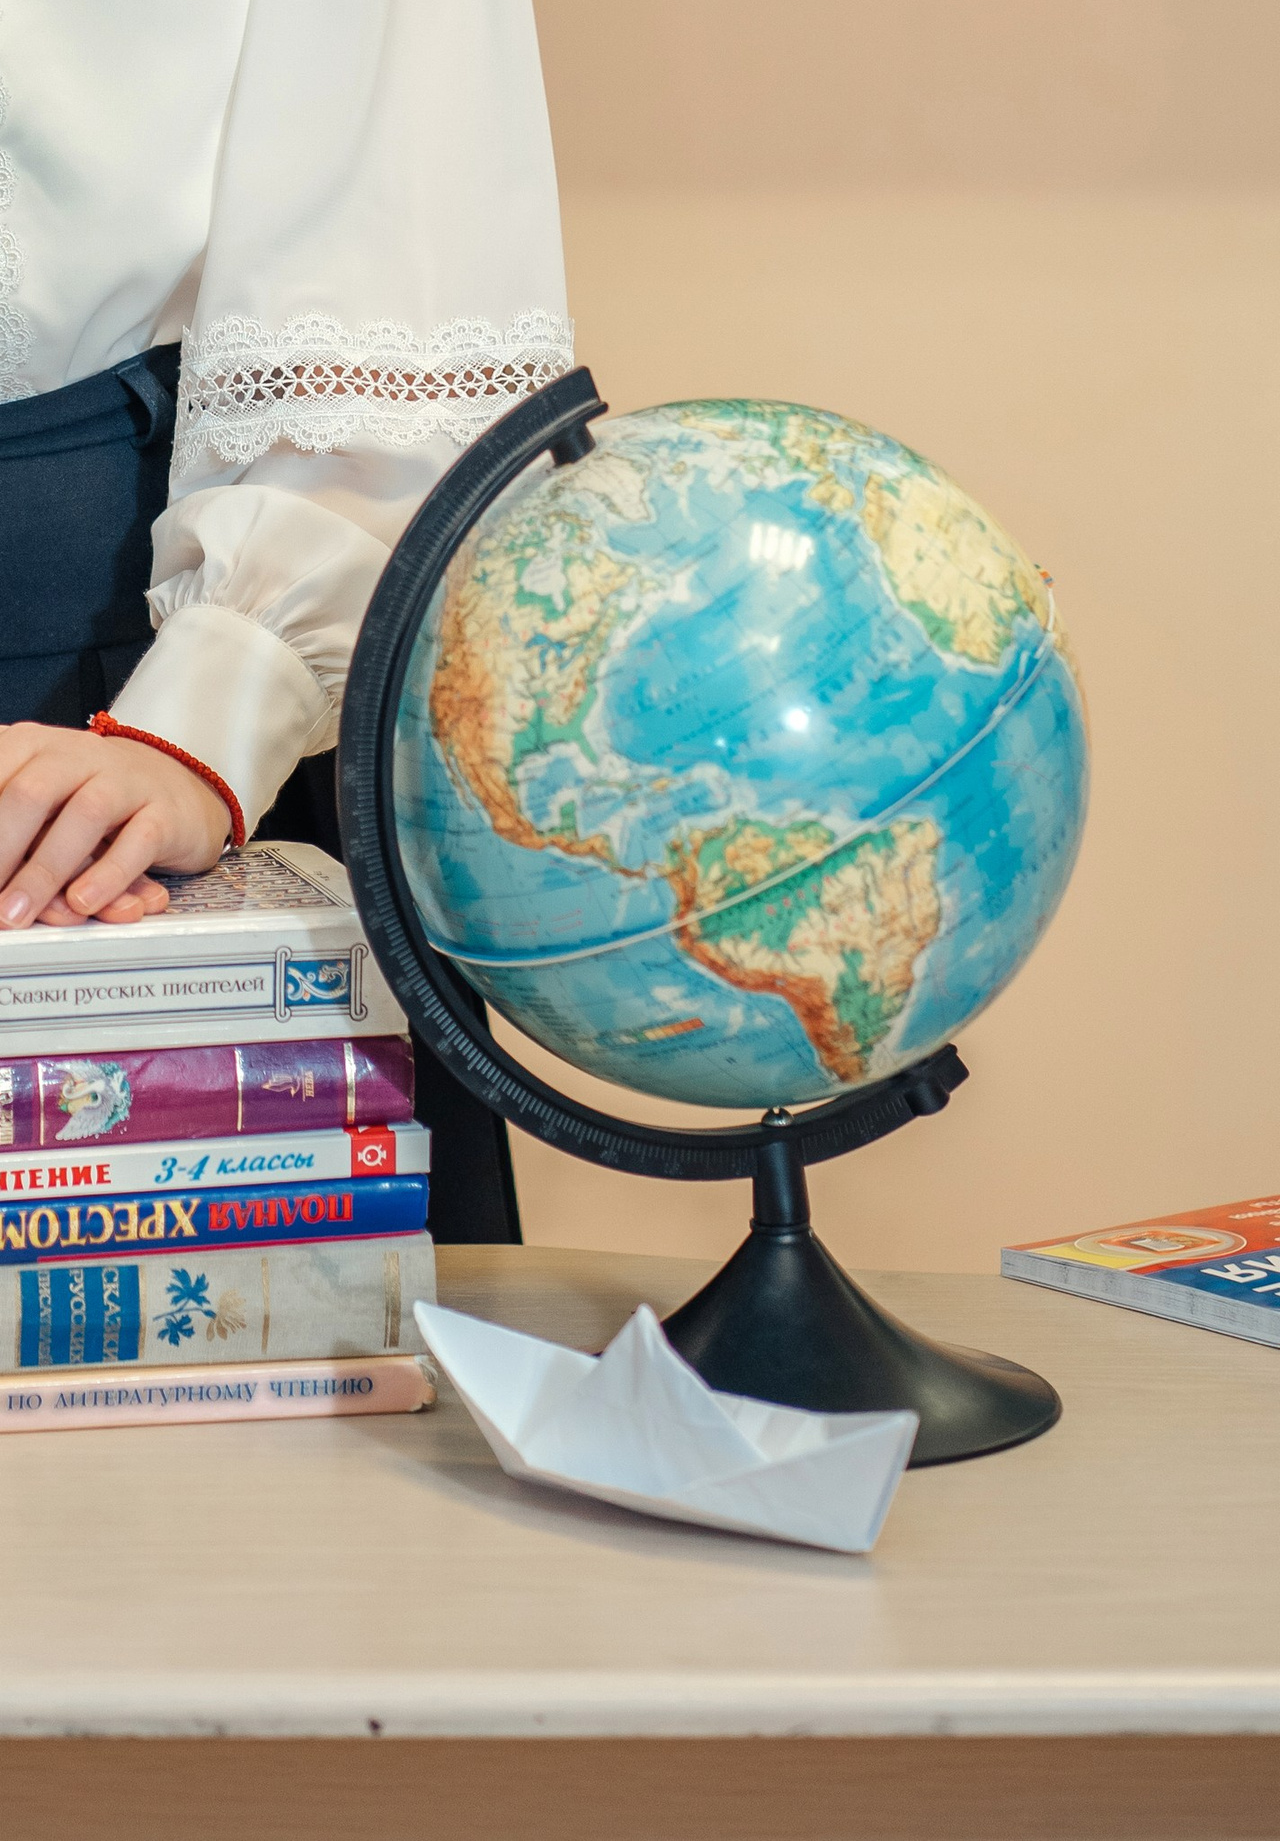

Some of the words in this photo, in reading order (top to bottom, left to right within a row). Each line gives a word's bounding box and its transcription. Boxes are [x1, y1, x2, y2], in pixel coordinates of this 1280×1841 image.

[74, 982, 155, 1006] русских
[161, 975, 266, 999] писателей
[153, 1154, 211, 1184] 3-4
[216, 1152, 315, 1176] классы
[208, 1192, 354, 1231] ПОЛНАЯ
[101, 1265, 121, 1363] СКАЗКИ
[7, 1393, 43, 1410] ПО
[54, 1381, 258, 1409] ЛИТЕРАТУРНОМУ
[269, 1376, 374, 1398] ЧТЕНИЮ
